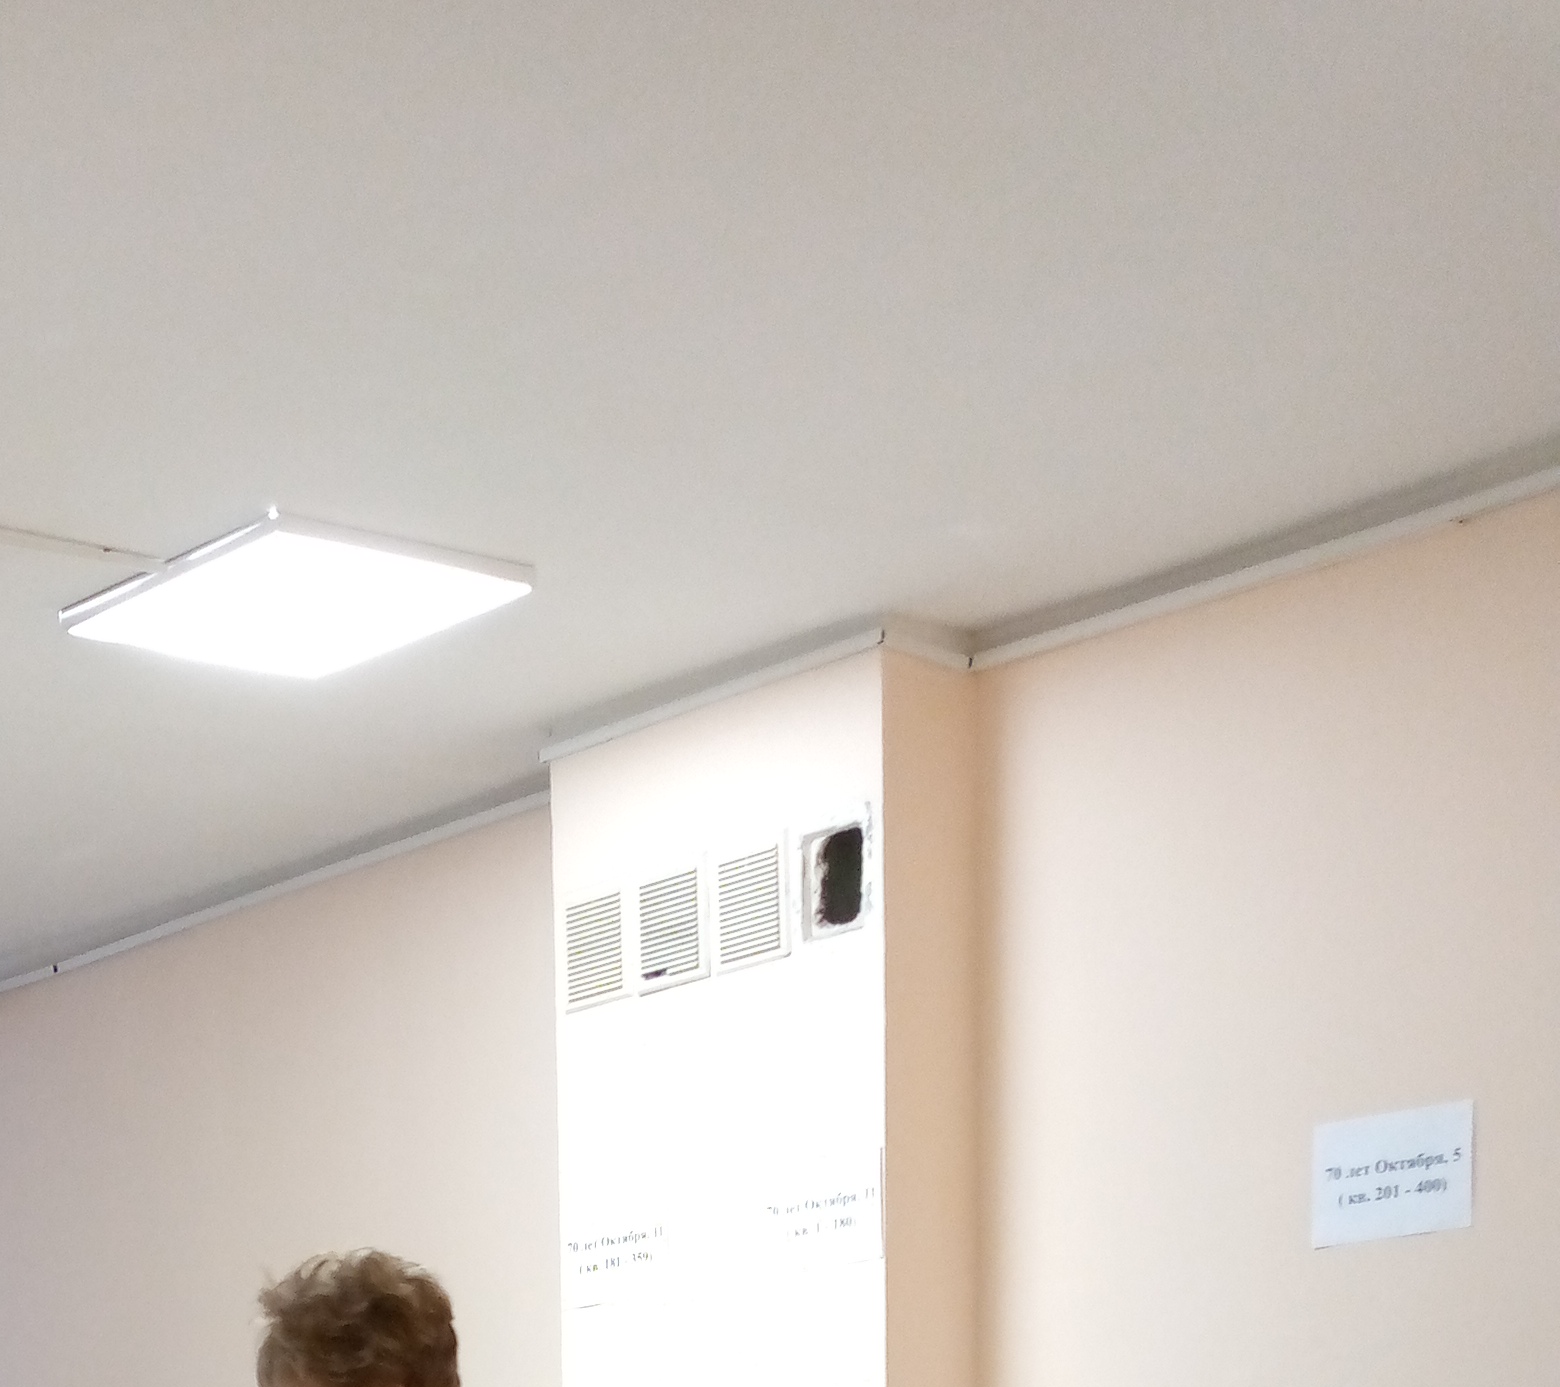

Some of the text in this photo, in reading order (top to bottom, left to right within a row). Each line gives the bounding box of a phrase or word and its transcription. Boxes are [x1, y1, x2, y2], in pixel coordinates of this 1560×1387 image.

[1325, 1166, 1342, 1181] 70
[1346, 1166, 1370, 1178] лет
[1453, 1147, 1461, 1162] 5
[1375, 1185, 1399, 1201] 201
